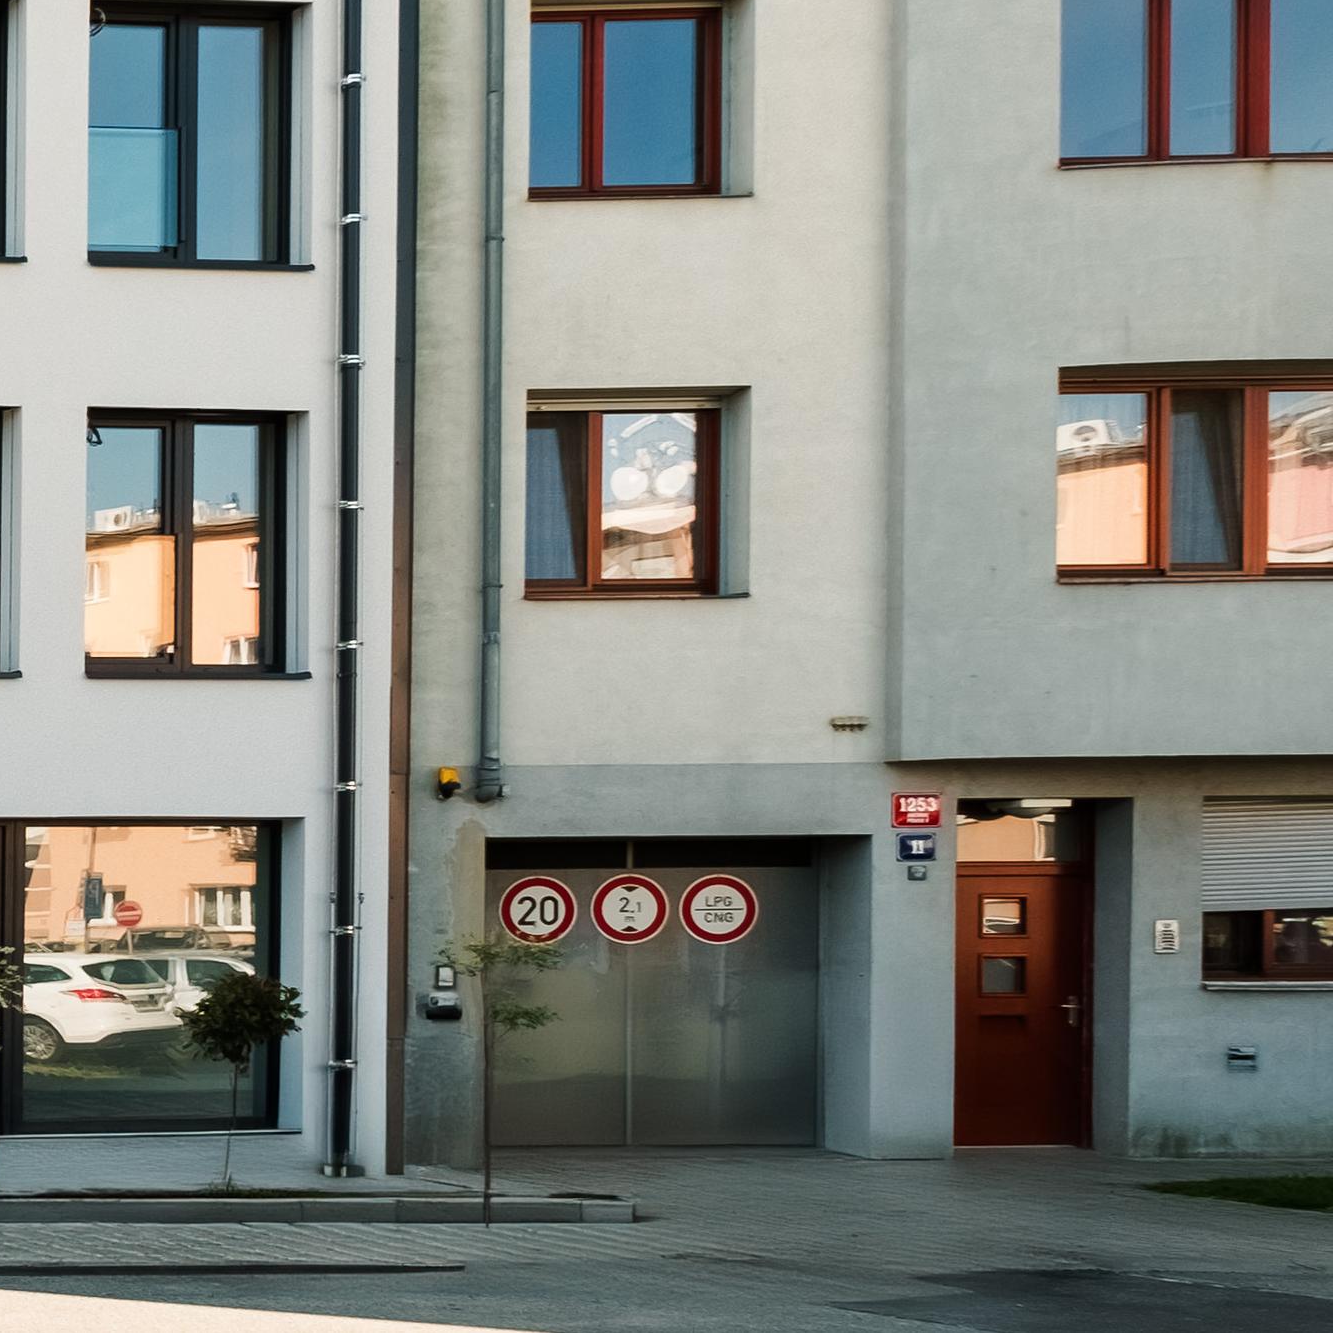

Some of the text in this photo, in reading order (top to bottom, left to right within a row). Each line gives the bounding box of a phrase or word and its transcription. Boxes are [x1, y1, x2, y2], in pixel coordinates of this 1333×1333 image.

[899, 797, 938, 812] 1253
[704, 895, 733, 908] LPG
[517, 895, 559, 926] 20
[703, 911, 734, 924] CNG
